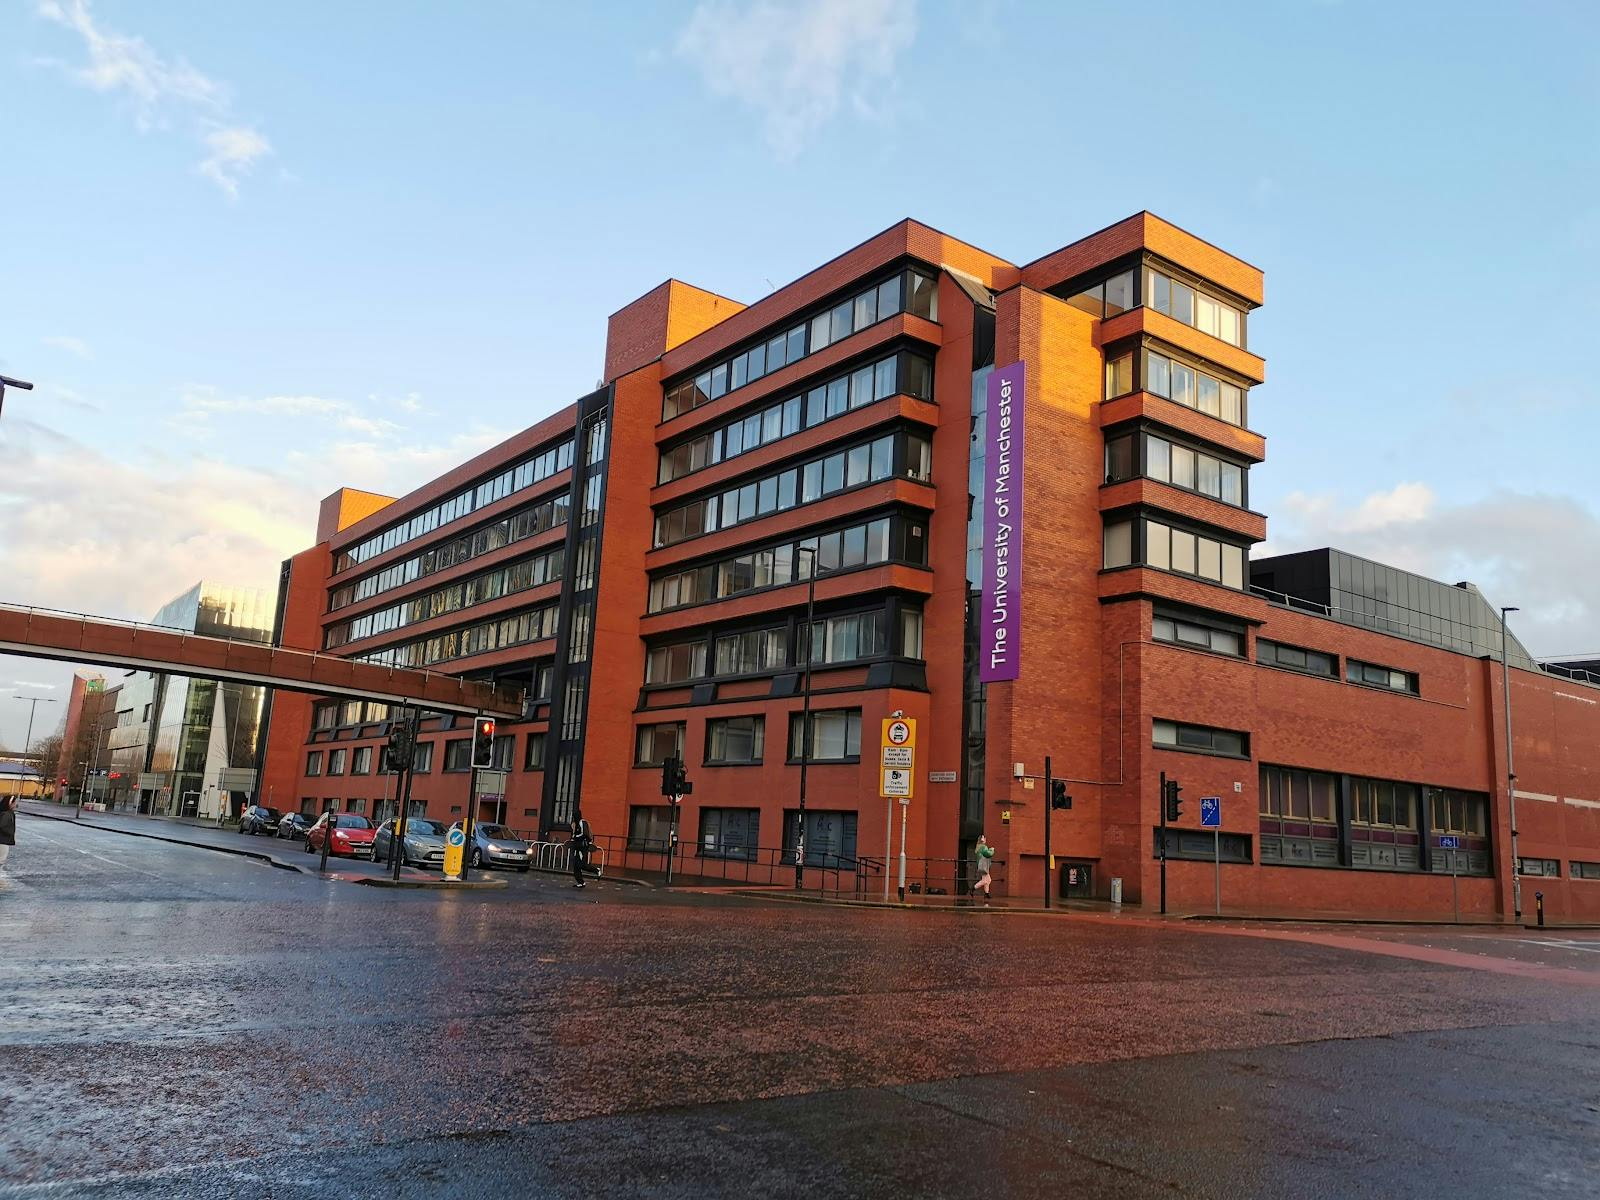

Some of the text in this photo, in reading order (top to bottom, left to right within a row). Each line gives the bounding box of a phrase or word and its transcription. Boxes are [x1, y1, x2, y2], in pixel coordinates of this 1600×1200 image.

[991, 379, 1012, 669] The University of Manchester
